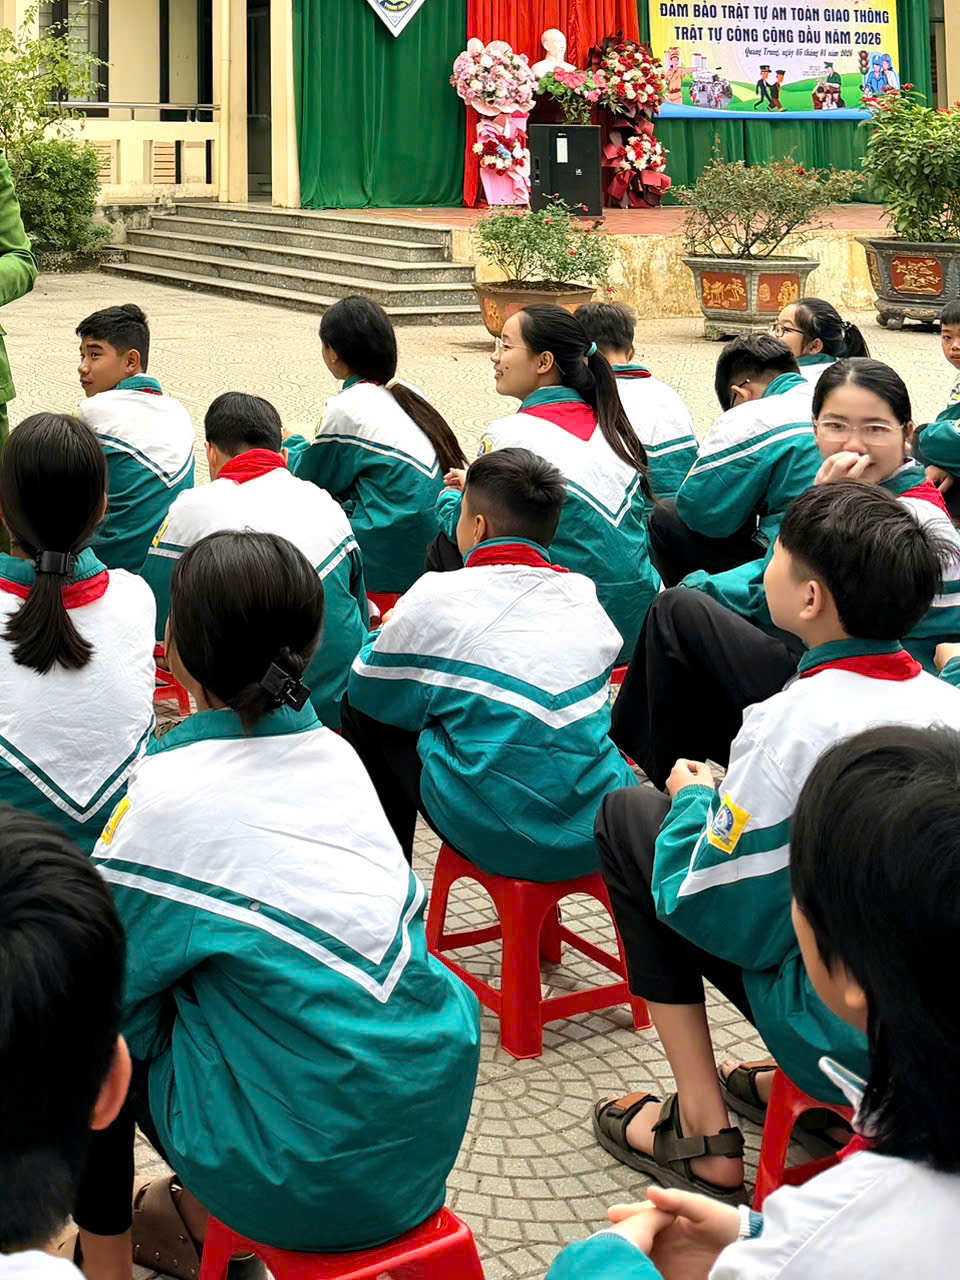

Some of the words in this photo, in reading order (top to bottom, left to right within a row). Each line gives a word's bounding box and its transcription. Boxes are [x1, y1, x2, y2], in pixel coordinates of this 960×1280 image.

[659, 0, 689, 18] ĐẢM
[693, 0, 717, 19] BẢO
[721, 2, 750, 22] TRẬT
[753, 5, 768, 23] TỰ
[771, 6, 787, 21] AN
[791, 5, 820, 22] TOÀN
[823, 8, 850, 23] GIAO
[853, 7, 889, 24] THÔNG
[674, 23, 703, 44] TRẬT
[707, 26, 722, 44] TỰ
[726, 25, 758, 42] CÔNG
[762, 26, 794, 46] CỘNG
[798, 25, 821, 44] ĐẦU
[825, 28, 851, 45] NĂM
[854, 31, 881, 45] 2026
